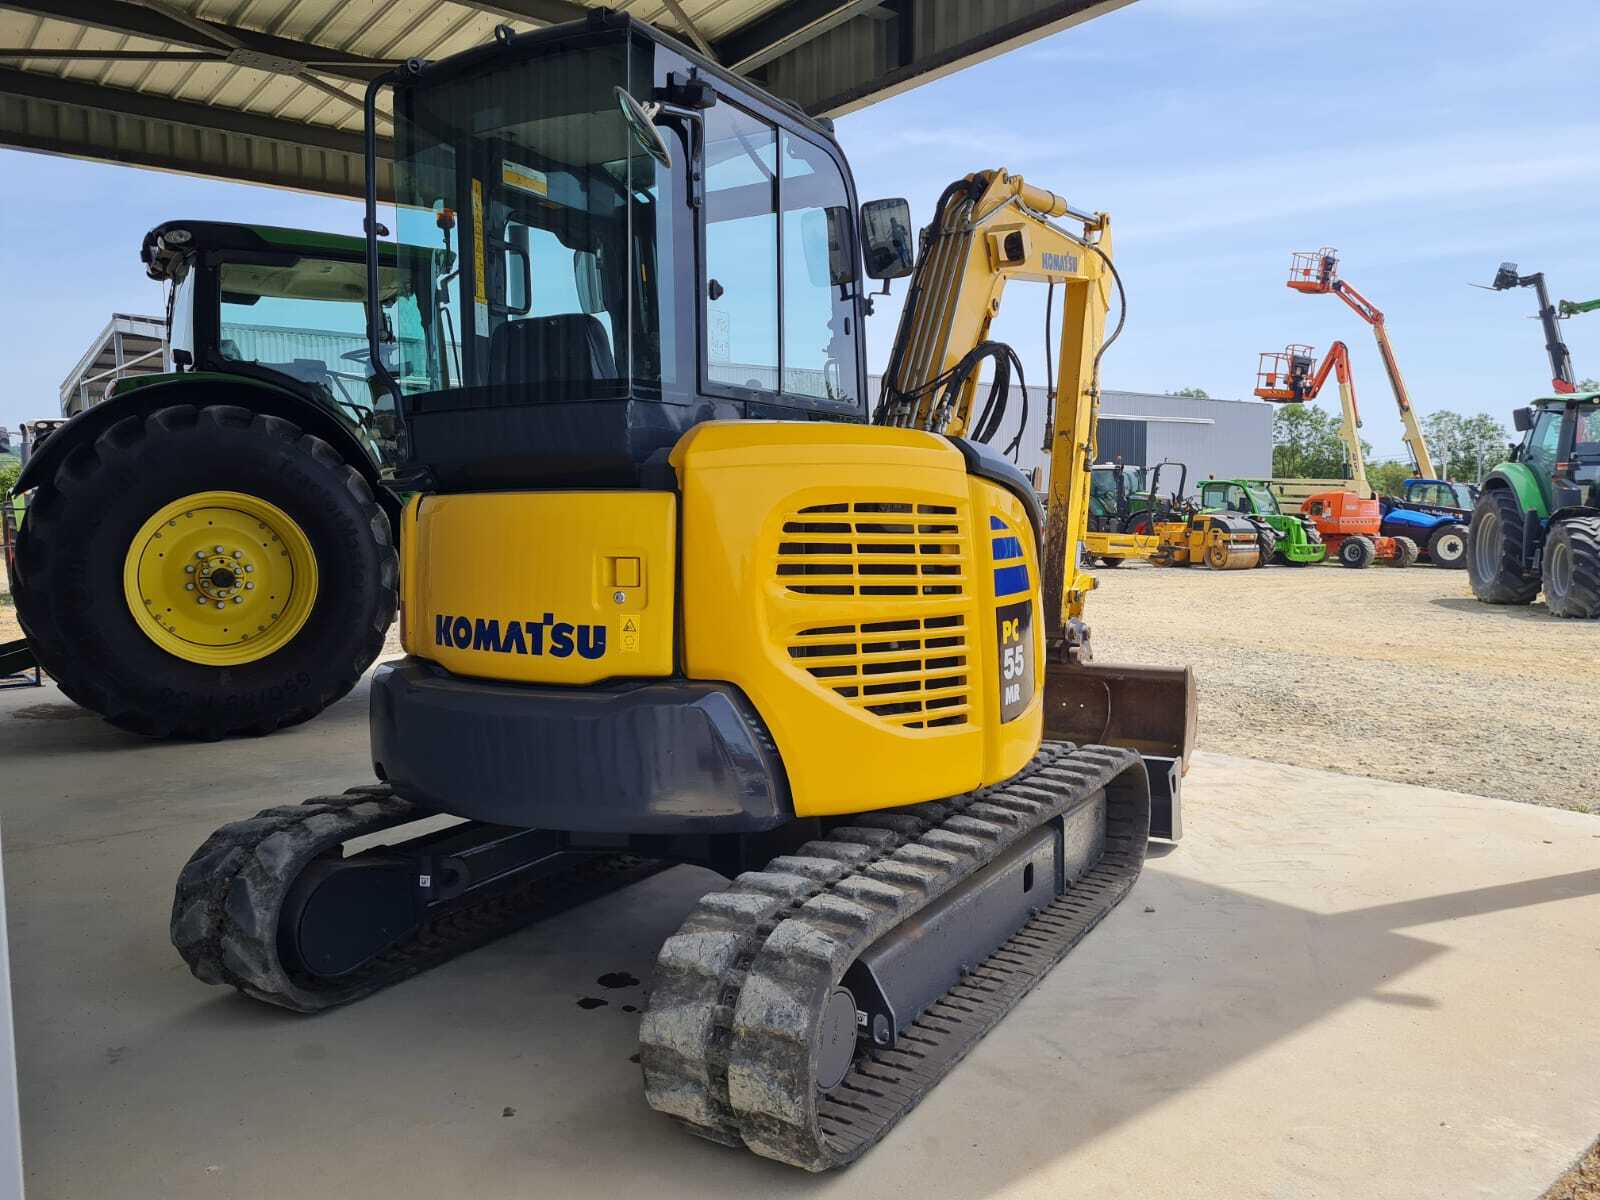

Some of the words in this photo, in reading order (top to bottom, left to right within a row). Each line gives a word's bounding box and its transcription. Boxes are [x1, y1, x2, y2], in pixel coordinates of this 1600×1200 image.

[1041, 251, 1078, 273] KOMATSU
[435, 613, 607, 660] KOMATSU
[1002, 618, 1020, 645] PC
[1003, 645, 1025, 680] 55
[1005, 683, 1020, 706] MR
